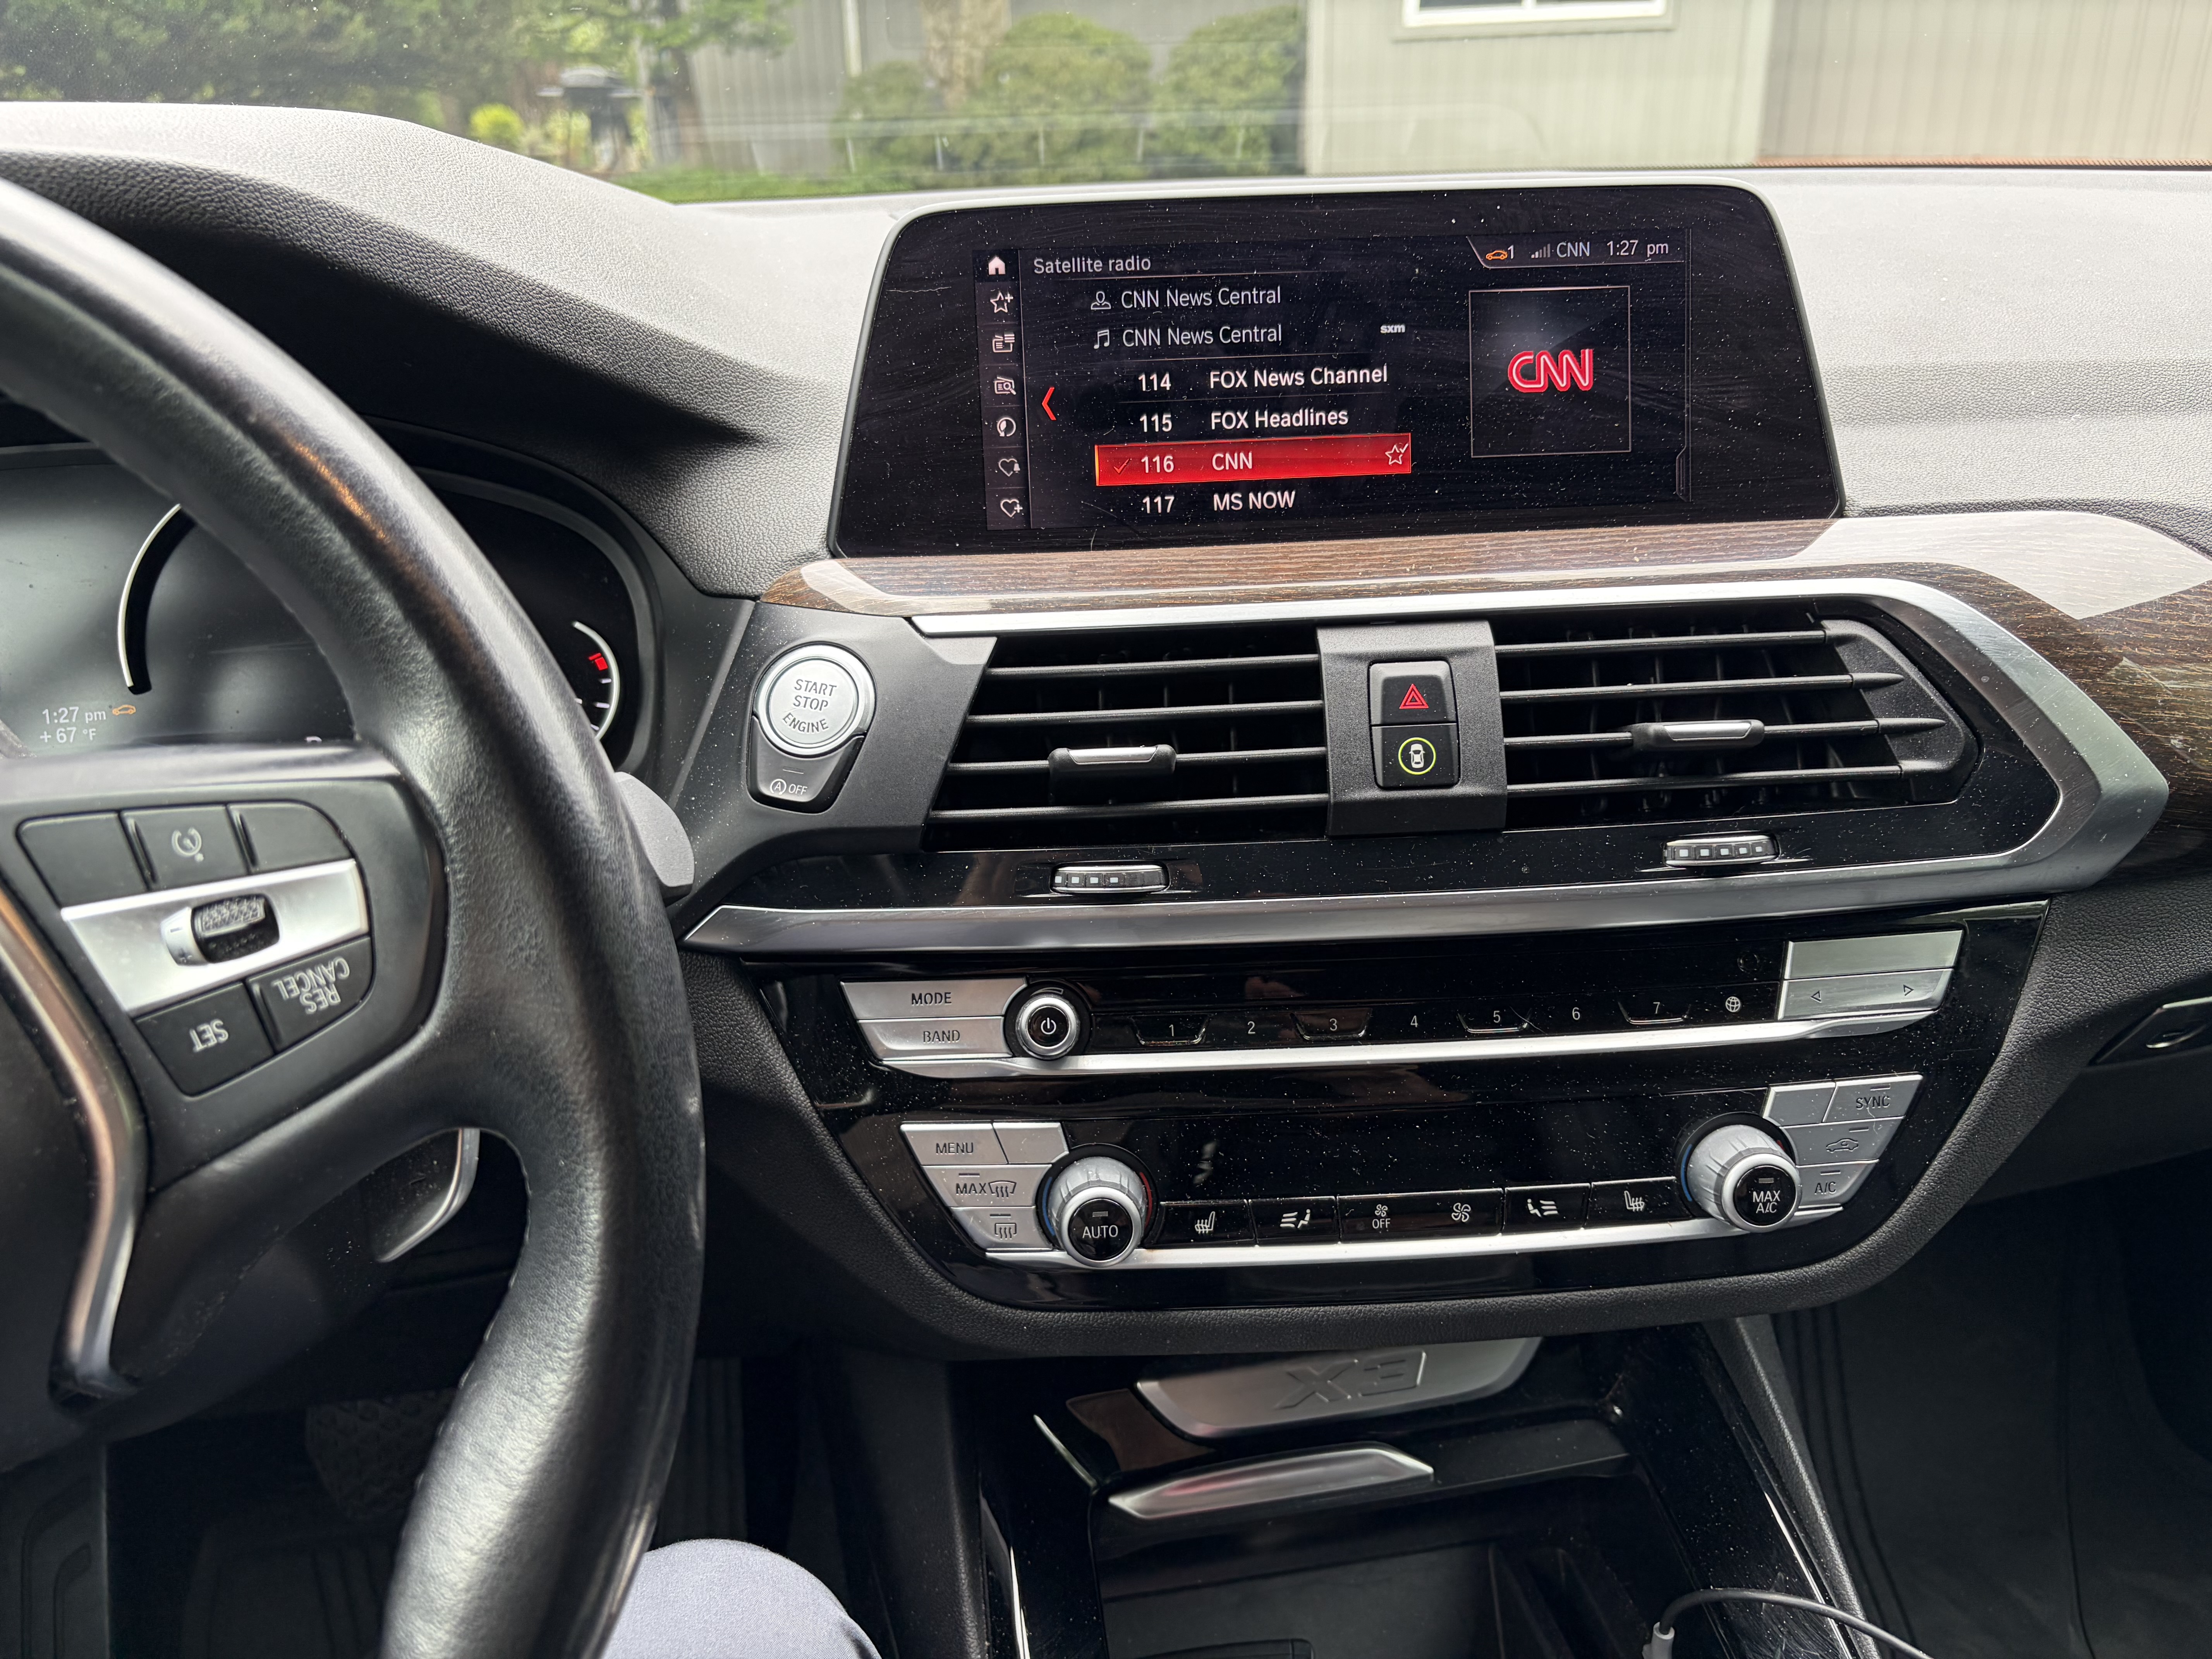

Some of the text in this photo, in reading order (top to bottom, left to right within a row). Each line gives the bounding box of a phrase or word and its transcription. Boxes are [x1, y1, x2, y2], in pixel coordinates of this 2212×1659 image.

[1507, 246, 1514, 259] 1
[1556, 242, 1590, 258] CNN
[1607, 240, 1669, 258] 1:27 pm
[1033, 255, 1151, 274] Satellite radio
[1121, 286, 1281, 308] CNN News Central
[1122, 324, 1282, 347] CNN News Central
[1380, 323, 1406, 334] sxm
[1138, 364, 1388, 391] 114 FOX News Channel
[1508, 348, 1594, 393] CNN
[1139, 409, 1349, 433] 115 FOX Headlines
[1140, 452, 1253, 474] 116 CNN
[1142, 490, 1296, 514] 117 MS NOW
[793, 678, 837, 697] START
[793, 695, 829, 712] STOP
[41, 706, 106, 725] 1:27 pm
[782, 712, 829, 733] ENGINE
[788, 783, 808, 795] OFF
[271, 956, 350, 1000] CANCEL
[299, 983, 341, 1015] RES
[910, 992, 953, 1006] MODE
[1168, 1001, 1660, 1037] 1 2 3 4 5 6 7
[189, 1019, 229, 1052] SET
[922, 1030, 961, 1044] BAND
[1855, 1095, 1891, 1109] SYNC
[935, 1142, 974, 1155] MENU
[955, 1183, 988, 1196] MAX
[1752, 1190, 1781, 1203] MAX
[1814, 1181, 1837, 1194] A/C
[1755, 1202, 1778, 1214] A/C
[1082, 1225, 1119, 1238] AUTO
[1372, 1218, 1391, 1230] OFF
[1274, 1348, 1427, 1410] X3
